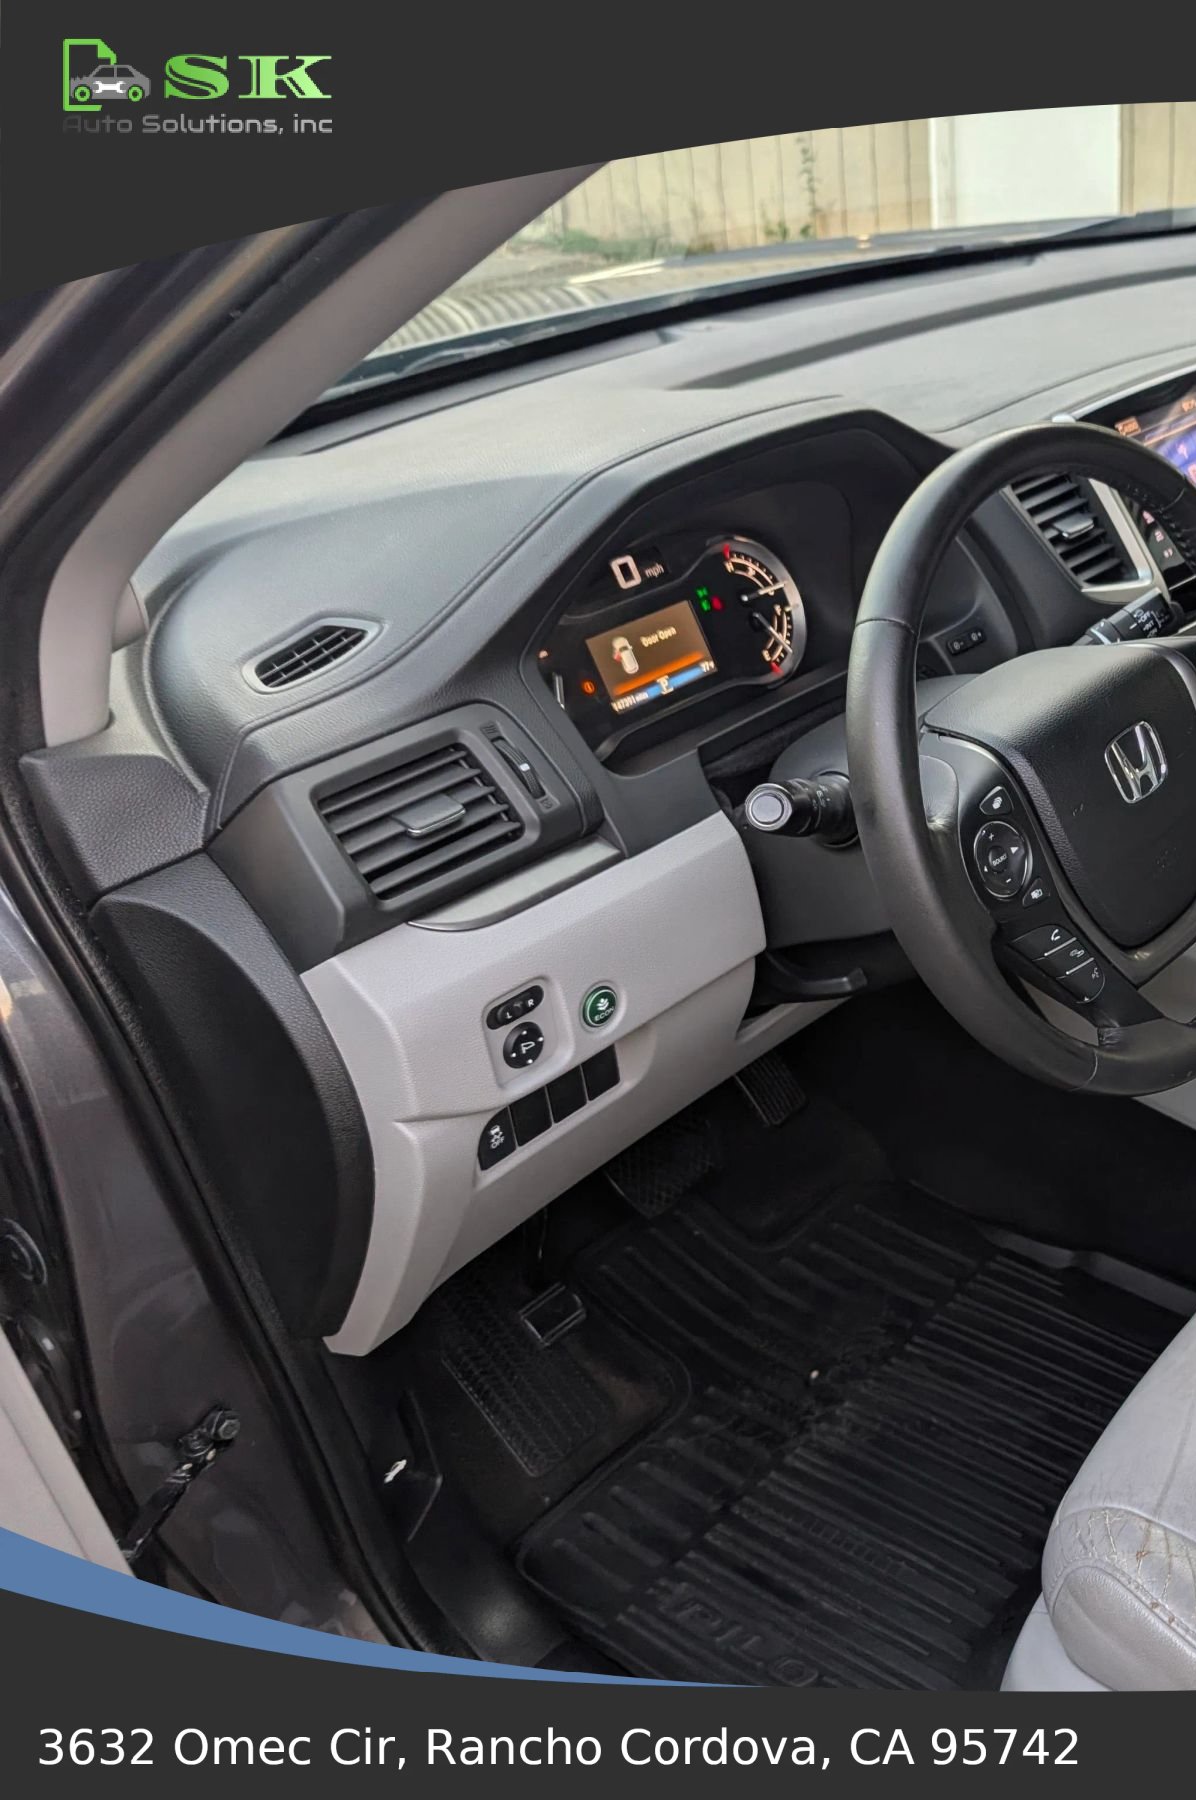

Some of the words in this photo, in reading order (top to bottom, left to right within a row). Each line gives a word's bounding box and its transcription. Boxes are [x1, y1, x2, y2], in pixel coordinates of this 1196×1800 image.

[611, 555, 642, 589] 0
[645, 563, 664, 578] mph
[640, 632, 659, 648] Door
[657, 625, 677, 642] Open
[528, 999, 535, 1007] R
[594, 1007, 615, 1021] ECON
[676, 1600, 842, 1687] PILO
